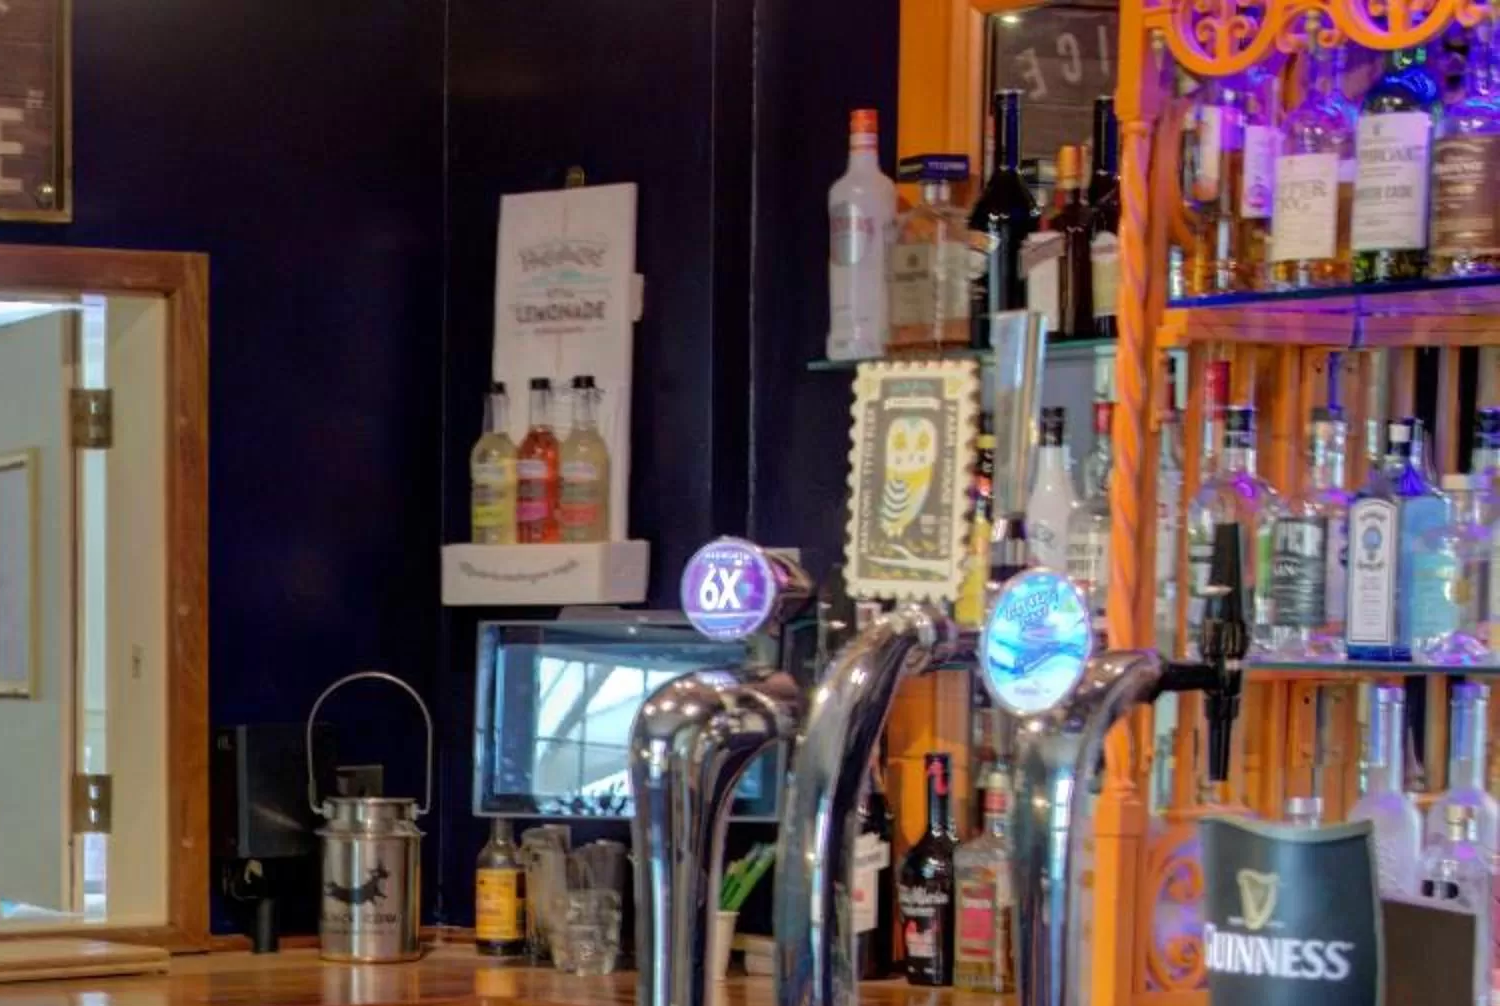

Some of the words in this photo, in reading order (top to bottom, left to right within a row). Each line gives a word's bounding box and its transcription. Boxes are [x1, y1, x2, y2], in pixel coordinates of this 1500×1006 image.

[514, 300, 606, 324] LEMONADE
[699, 562, 741, 612] 6X
[1204, 922, 1352, 981] GUINNESS
